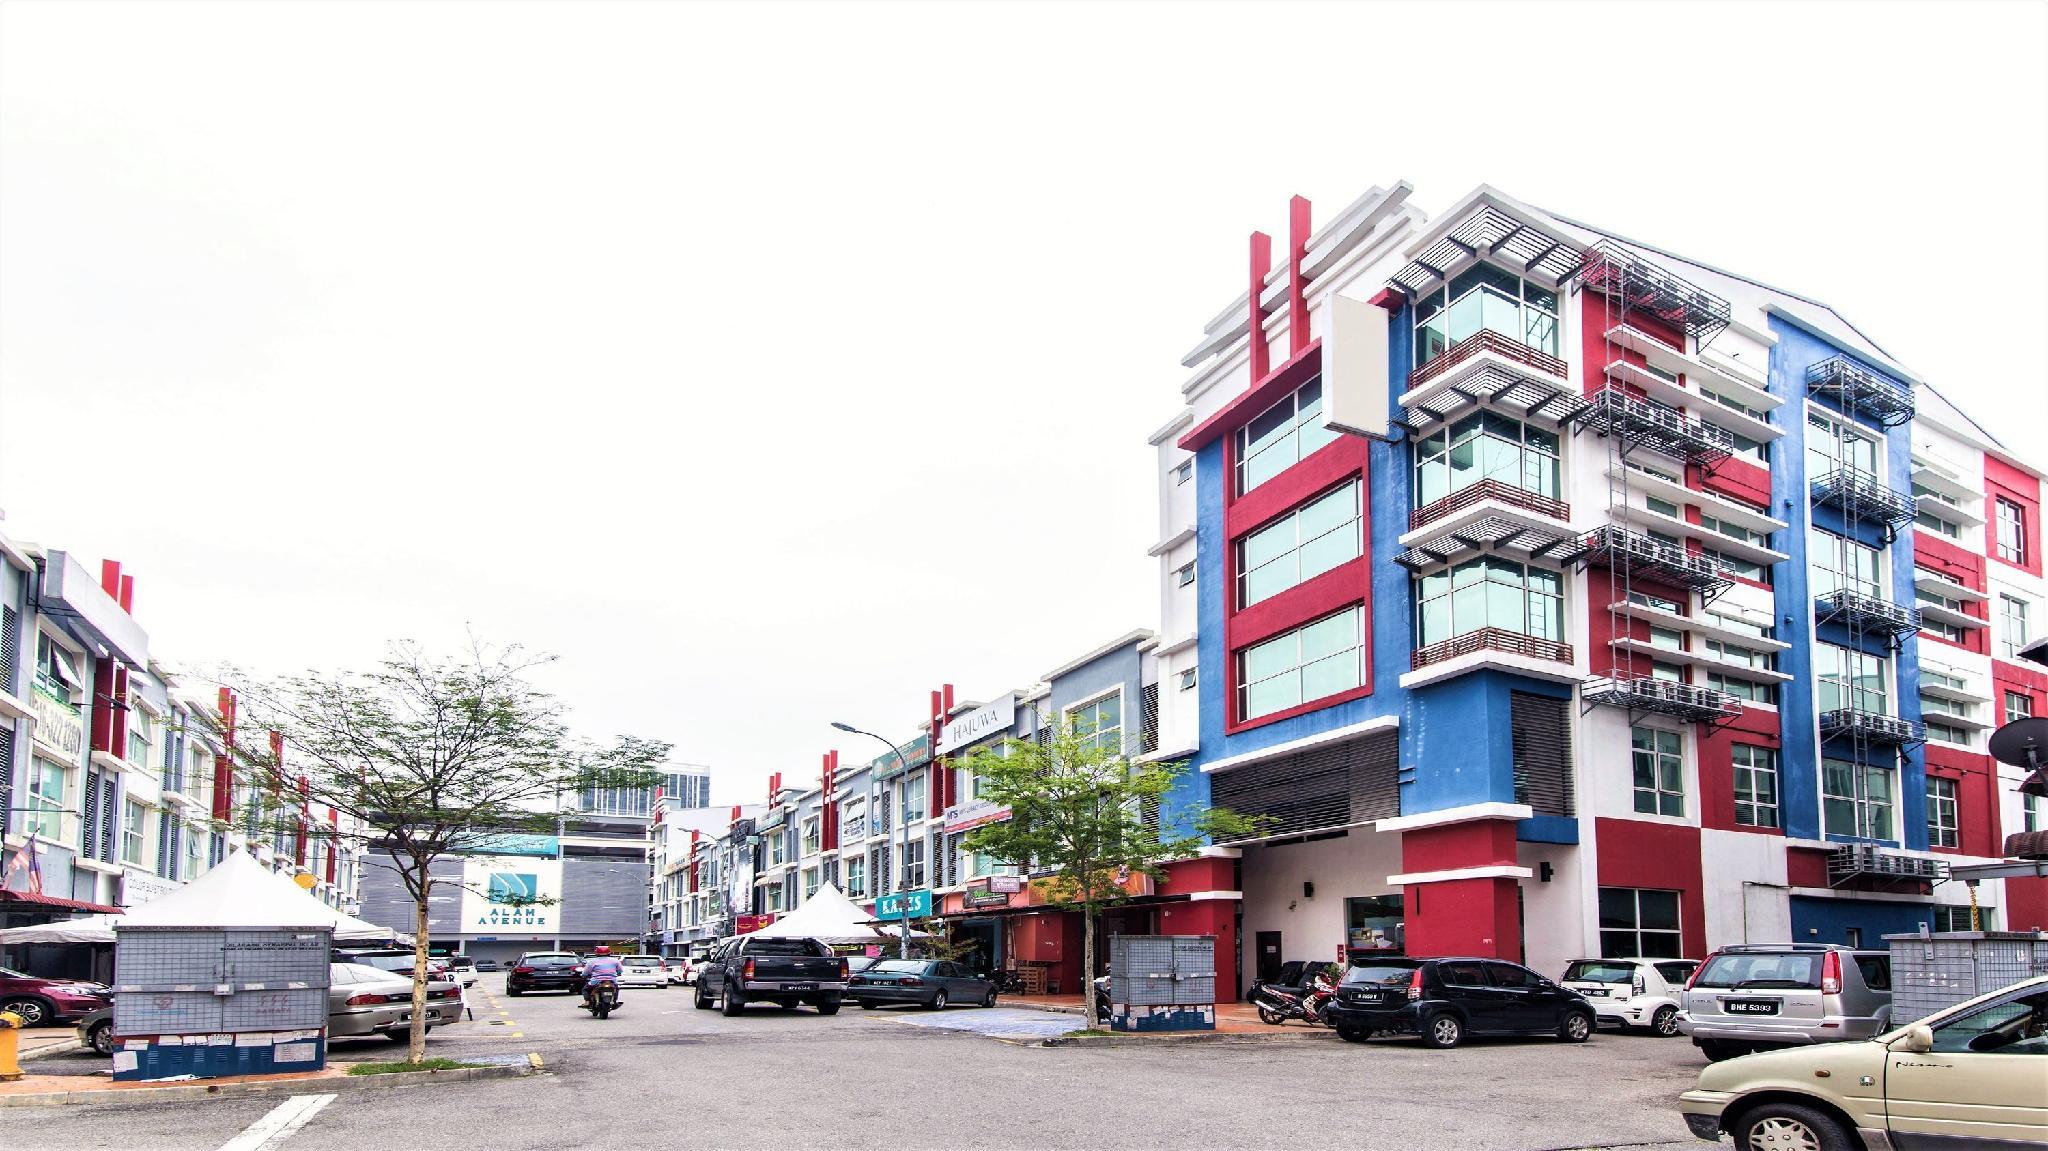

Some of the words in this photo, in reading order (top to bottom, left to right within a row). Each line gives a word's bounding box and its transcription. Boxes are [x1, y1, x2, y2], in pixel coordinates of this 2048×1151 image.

[953, 709, 998, 742] HAJUWA
[489, 908, 536, 917] ALAM
[478, 917, 546, 925] AVENUE
